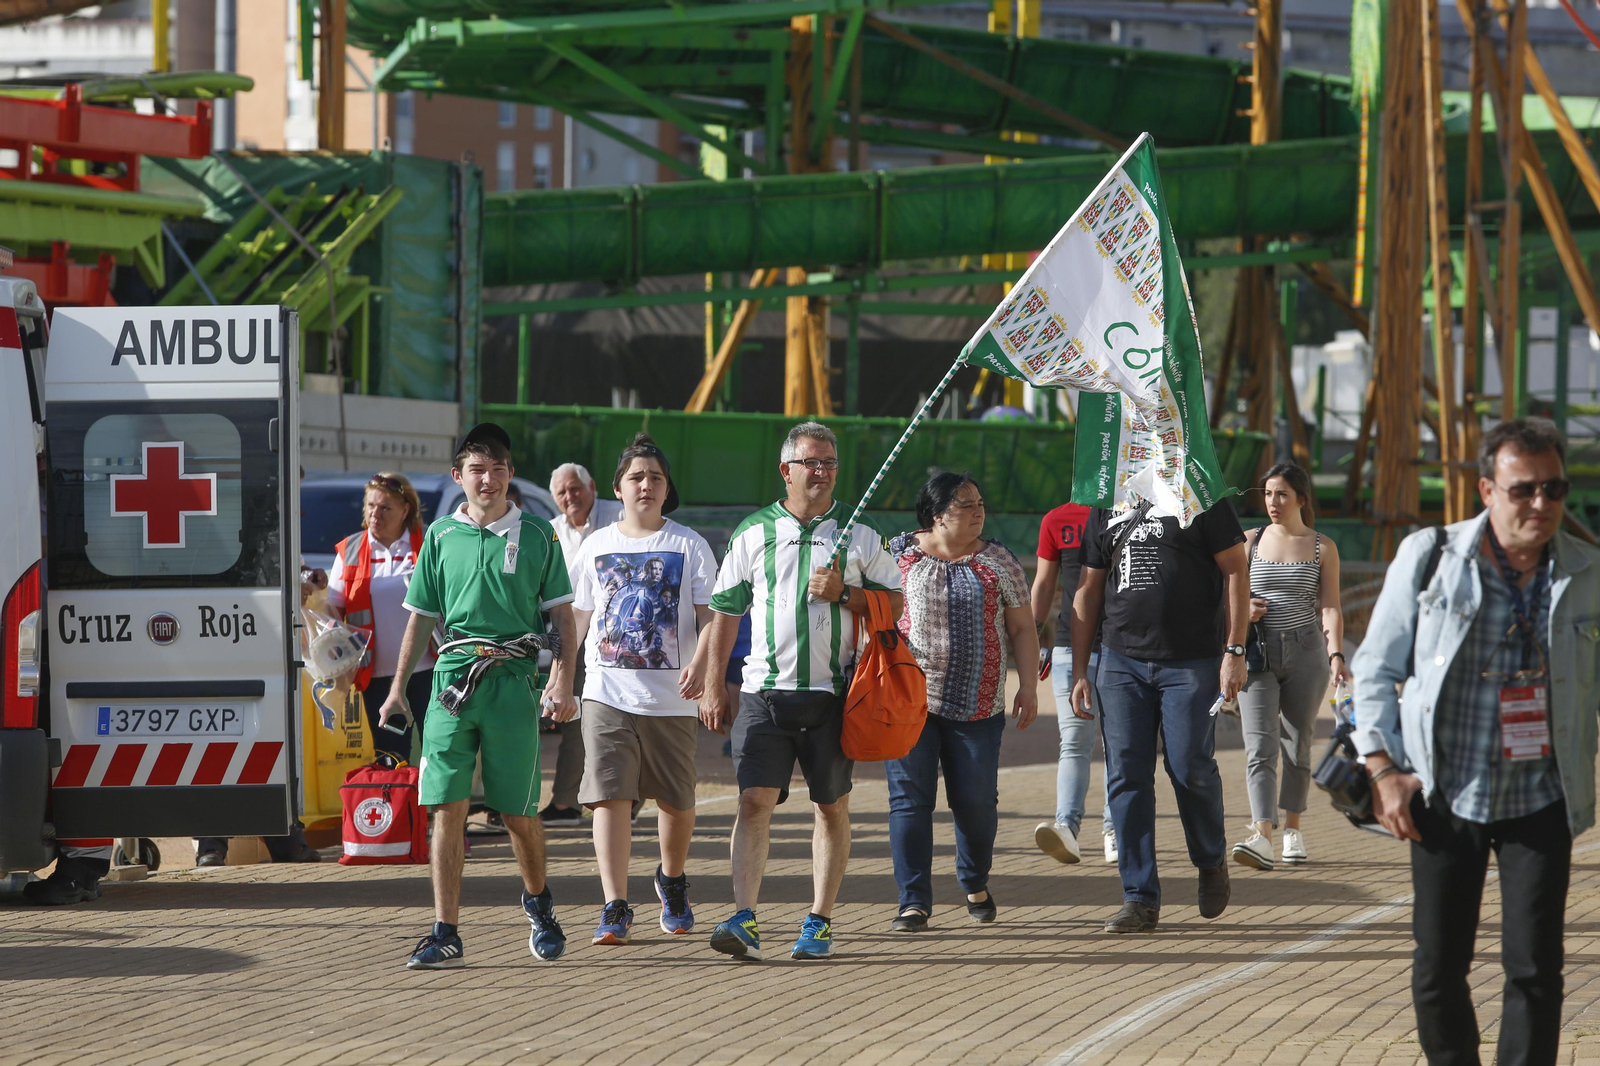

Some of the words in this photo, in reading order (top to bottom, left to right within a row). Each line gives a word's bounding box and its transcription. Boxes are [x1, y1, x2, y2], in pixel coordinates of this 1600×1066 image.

[110, 318, 281, 366] AMBUL
[1100, 431, 1112, 462] pasión
[1097, 464, 1111, 500] infinita
[58, 604, 132, 645] Cruz
[198, 604, 257, 644] Roja
[154, 621, 173, 637] FIAT
[115, 708, 180, 732] 3797
[189, 708, 236, 732] GXP
